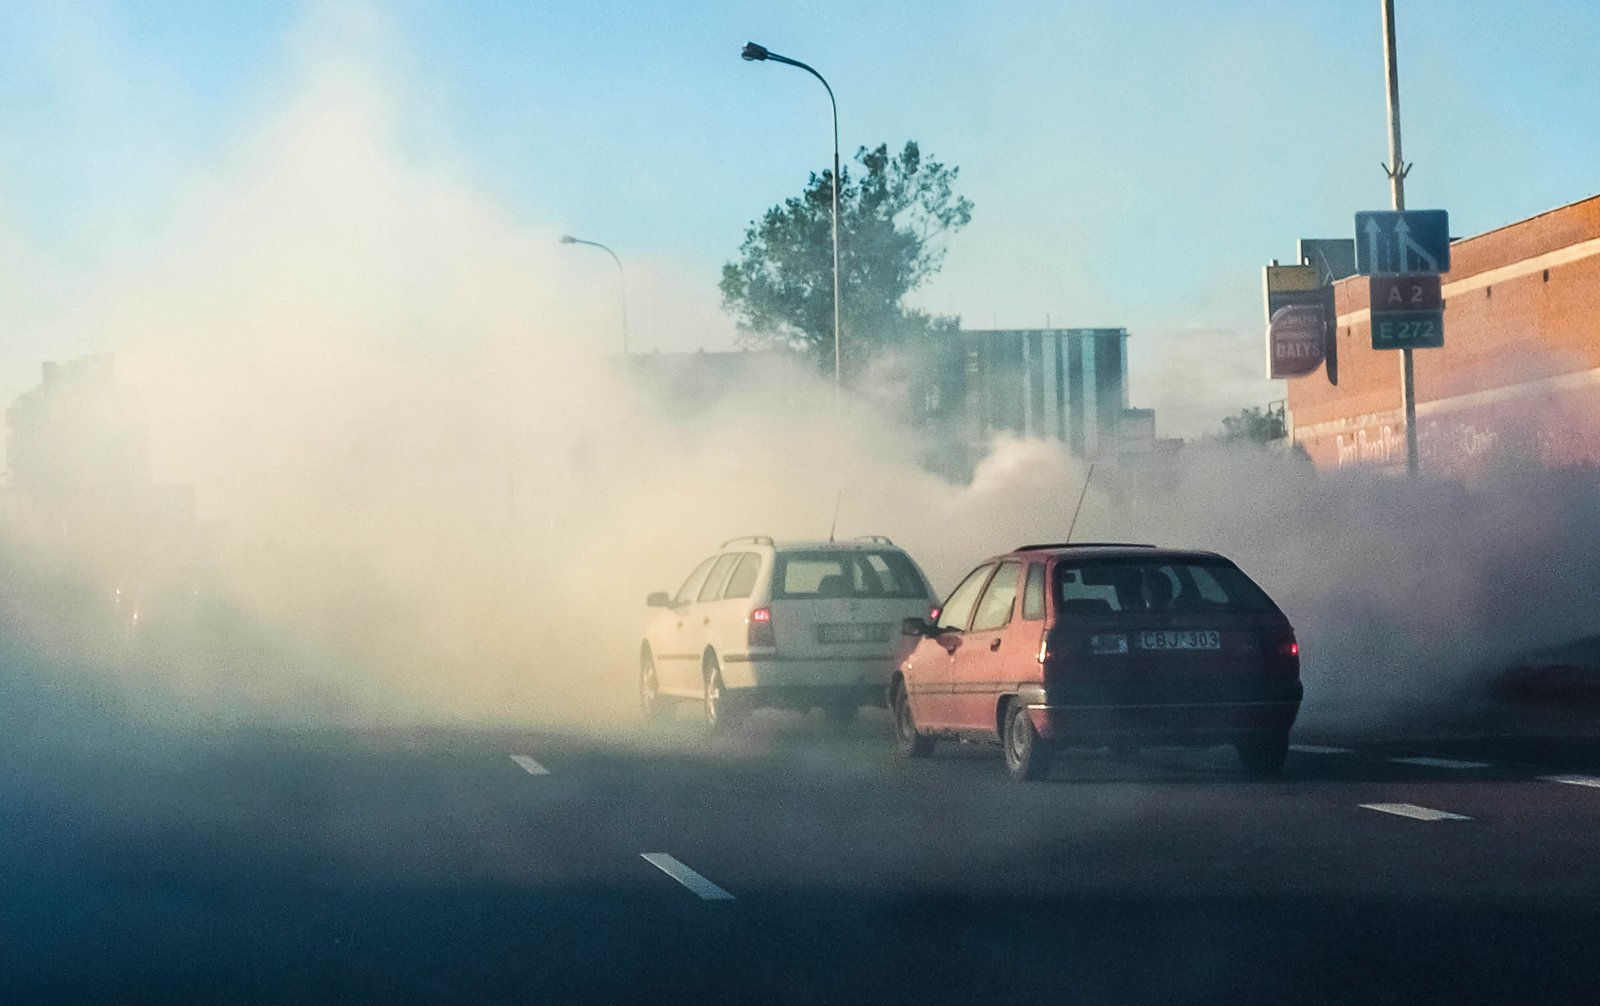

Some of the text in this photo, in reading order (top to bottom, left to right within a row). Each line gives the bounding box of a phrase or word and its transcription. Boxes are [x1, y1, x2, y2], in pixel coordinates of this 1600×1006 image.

[1388, 285, 1423, 303] A 2
[1379, 320, 1435, 339] E 272
[1275, 341, 1321, 359] DALYS
[1144, 631, 1219, 648] CBJ 303
